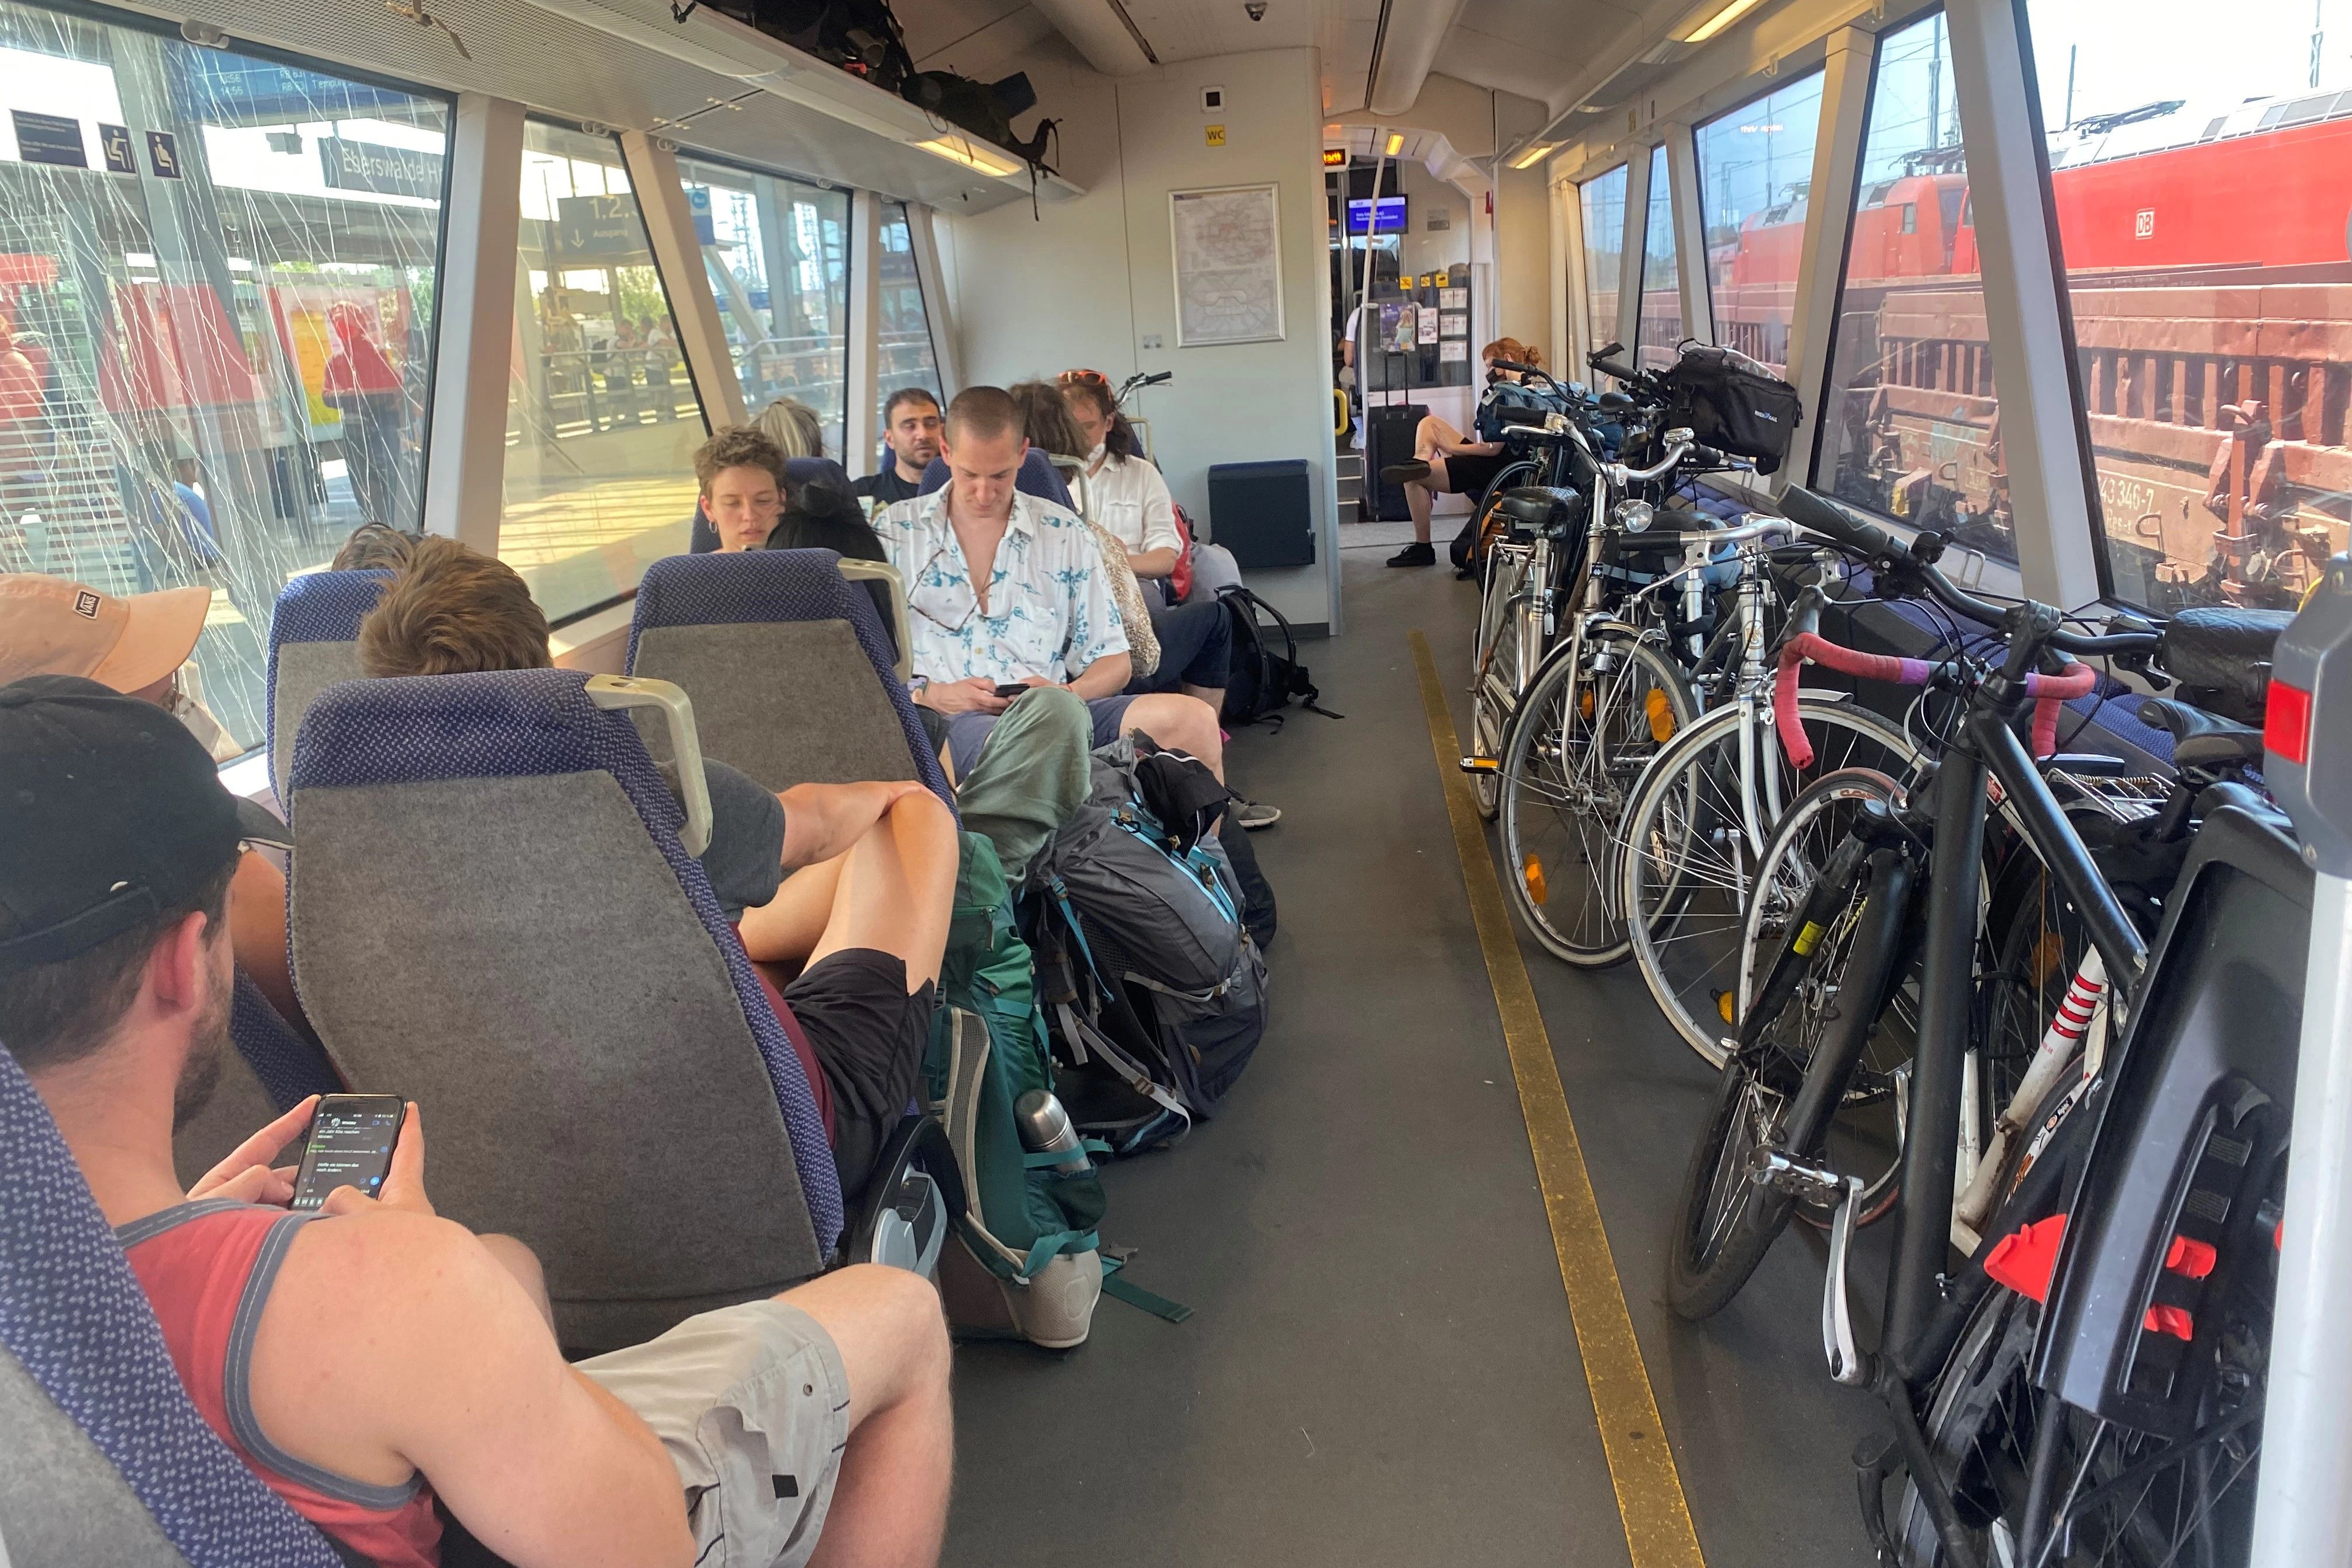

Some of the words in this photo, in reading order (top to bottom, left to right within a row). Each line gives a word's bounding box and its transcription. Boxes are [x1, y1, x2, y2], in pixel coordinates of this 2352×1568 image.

[1207, 130, 1223, 140] WC
[2138, 214, 2151, 233] DB
[78, 594, 96, 613] VANS
